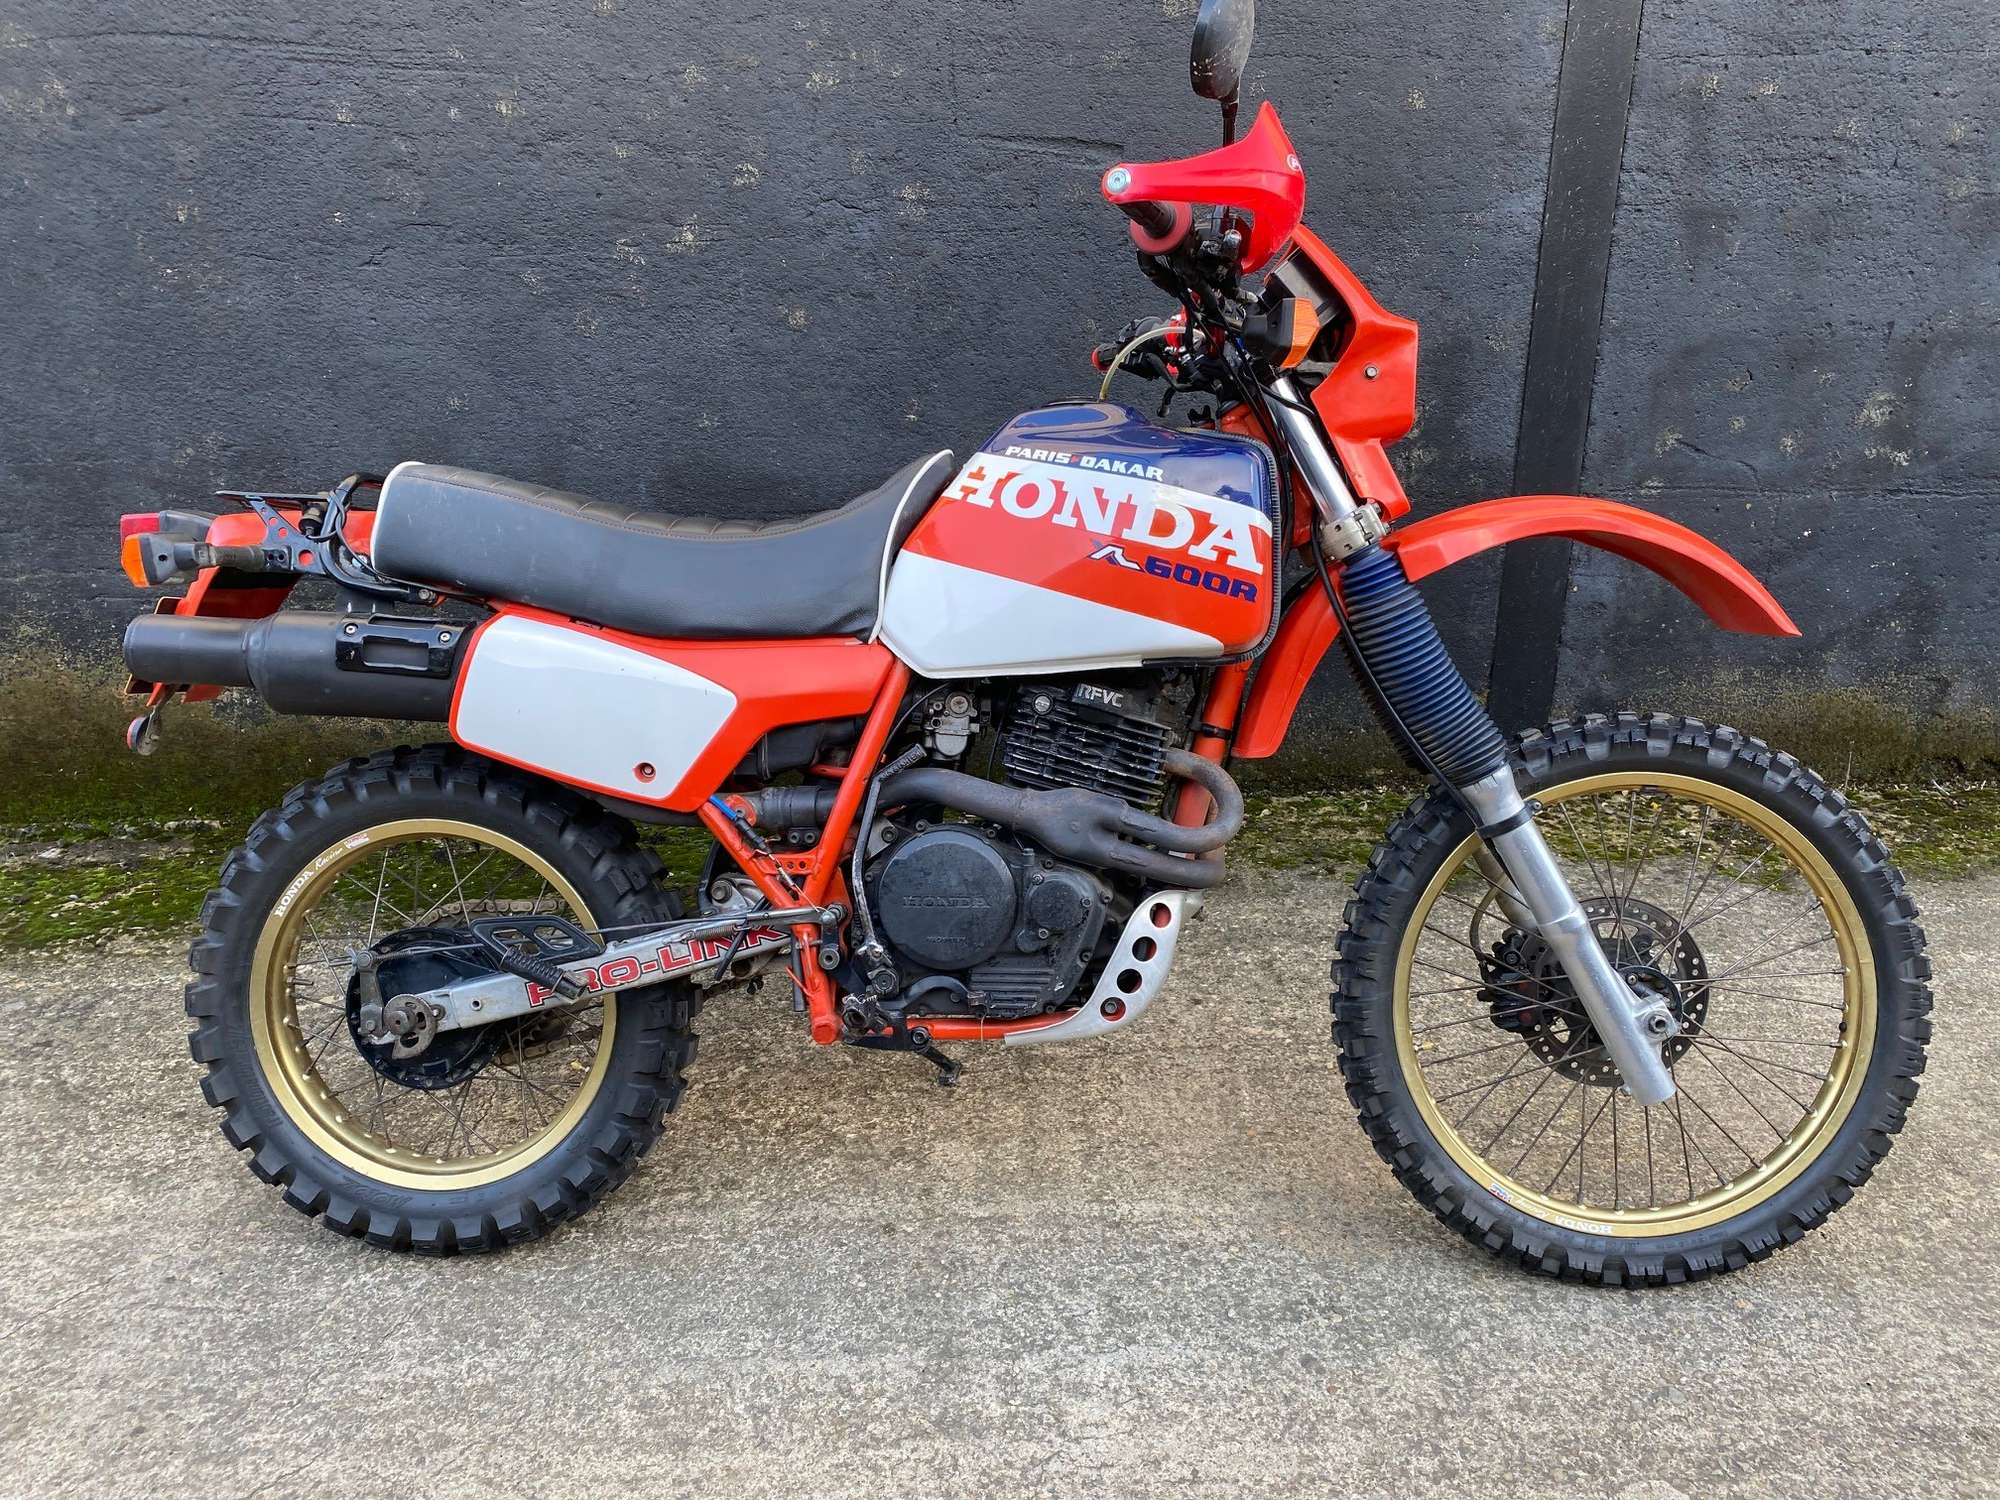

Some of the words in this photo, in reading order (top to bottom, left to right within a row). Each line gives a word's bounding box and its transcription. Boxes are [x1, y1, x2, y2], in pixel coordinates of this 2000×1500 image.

[1004, 446, 1071, 464] PARIS
[1080, 454, 1164, 481] DAKAR
[942, 463, 1264, 575] HONDA
[1077, 683, 1125, 708] RFVC
[273, 870, 315, 918] HONDA
[903, 895, 992, 909] HONDA
[1555, 1215, 1613, 1234] HONDA
